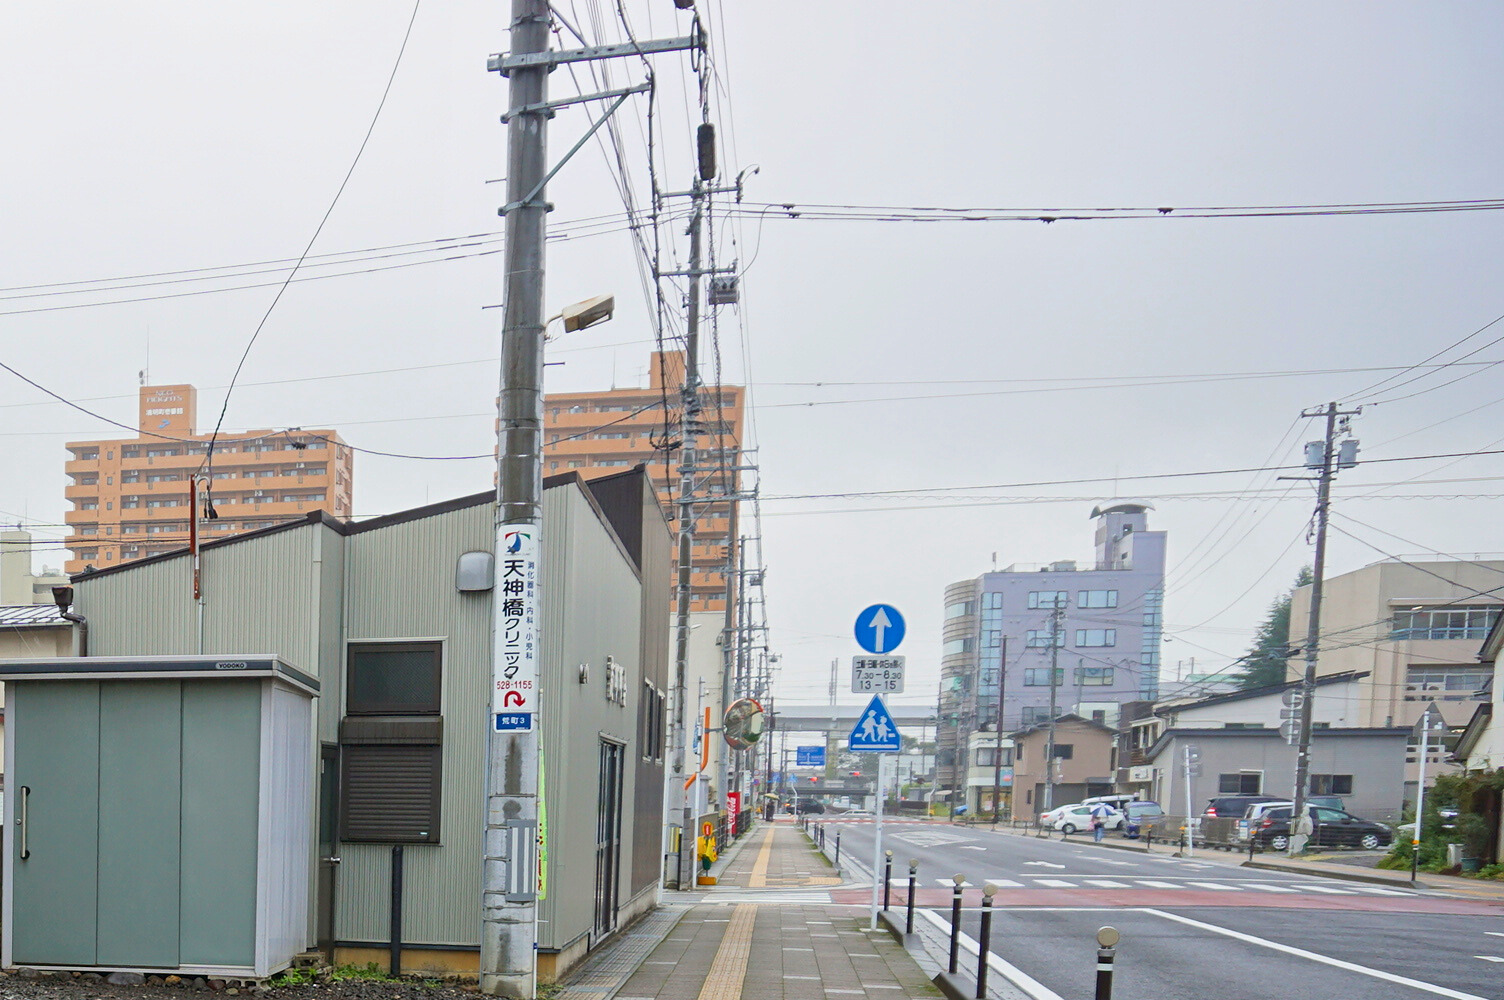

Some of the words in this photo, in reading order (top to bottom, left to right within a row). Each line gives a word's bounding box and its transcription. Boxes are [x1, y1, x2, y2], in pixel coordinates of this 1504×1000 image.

[502, 559, 524, 679] 天神橋クリニック
[496, 680, 532, 689] 528-1155
